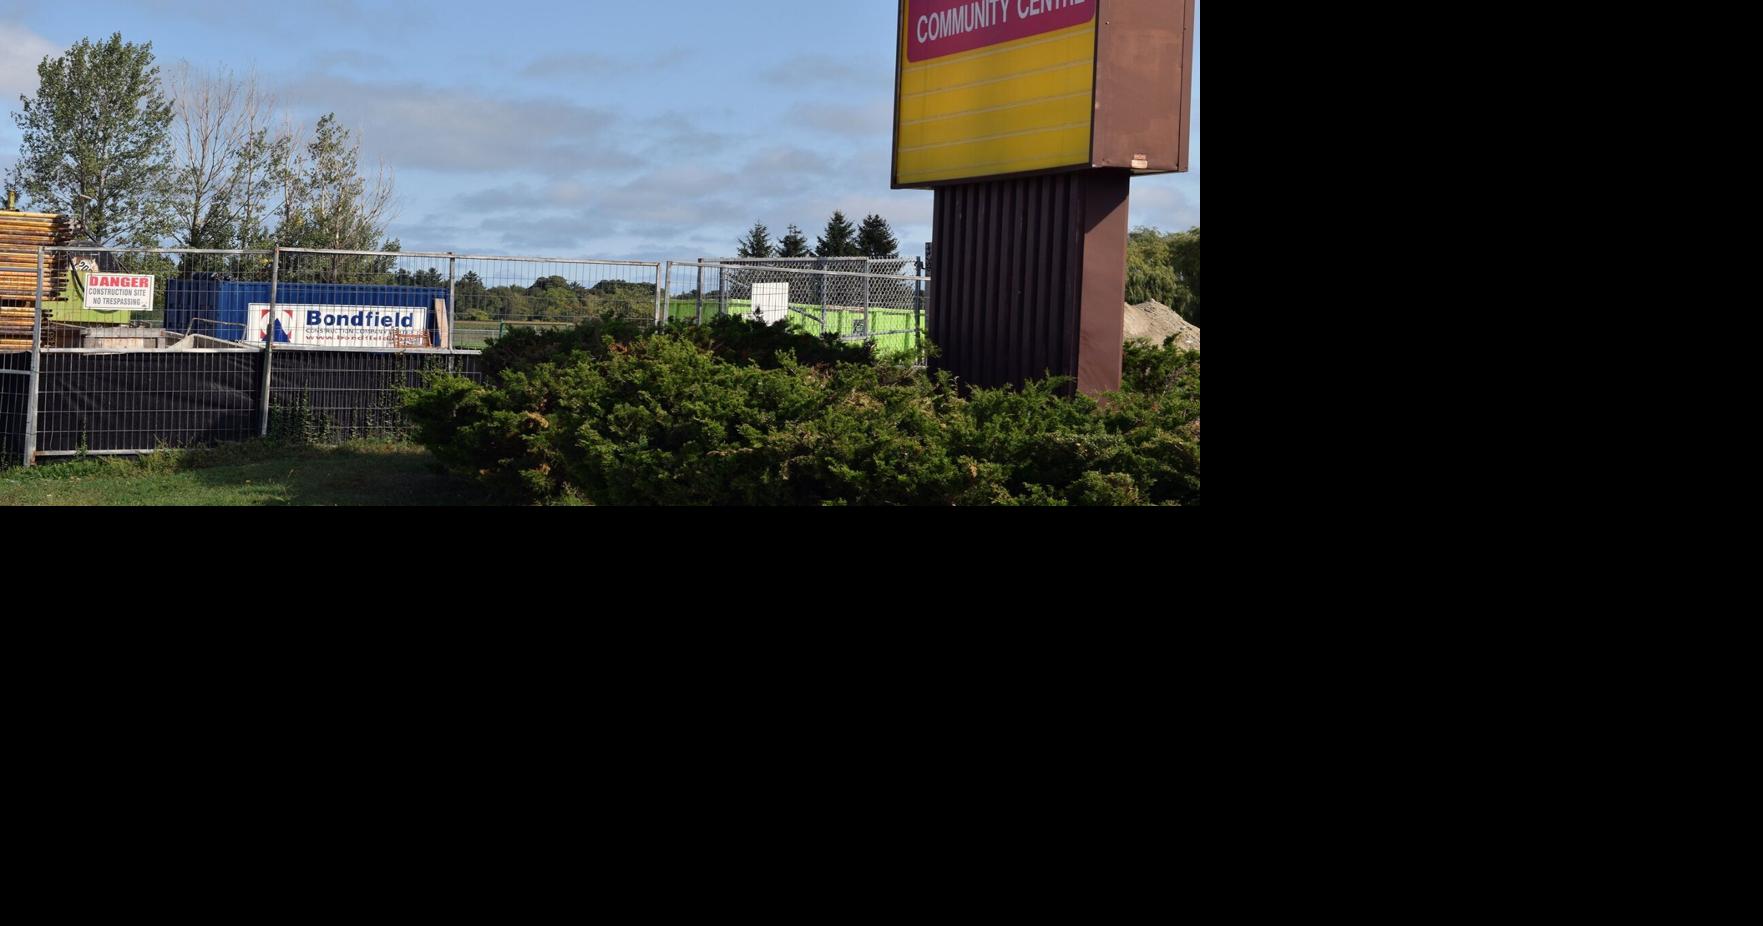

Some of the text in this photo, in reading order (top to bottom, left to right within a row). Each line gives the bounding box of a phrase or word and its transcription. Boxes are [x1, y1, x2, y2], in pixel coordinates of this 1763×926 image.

[917, 0, 1008, 43] COMMUNITY
[89, 276, 149, 287] DANGER
[88, 288, 132, 296] CONSTRUCTION
[306, 310, 413, 327] Bondfield
